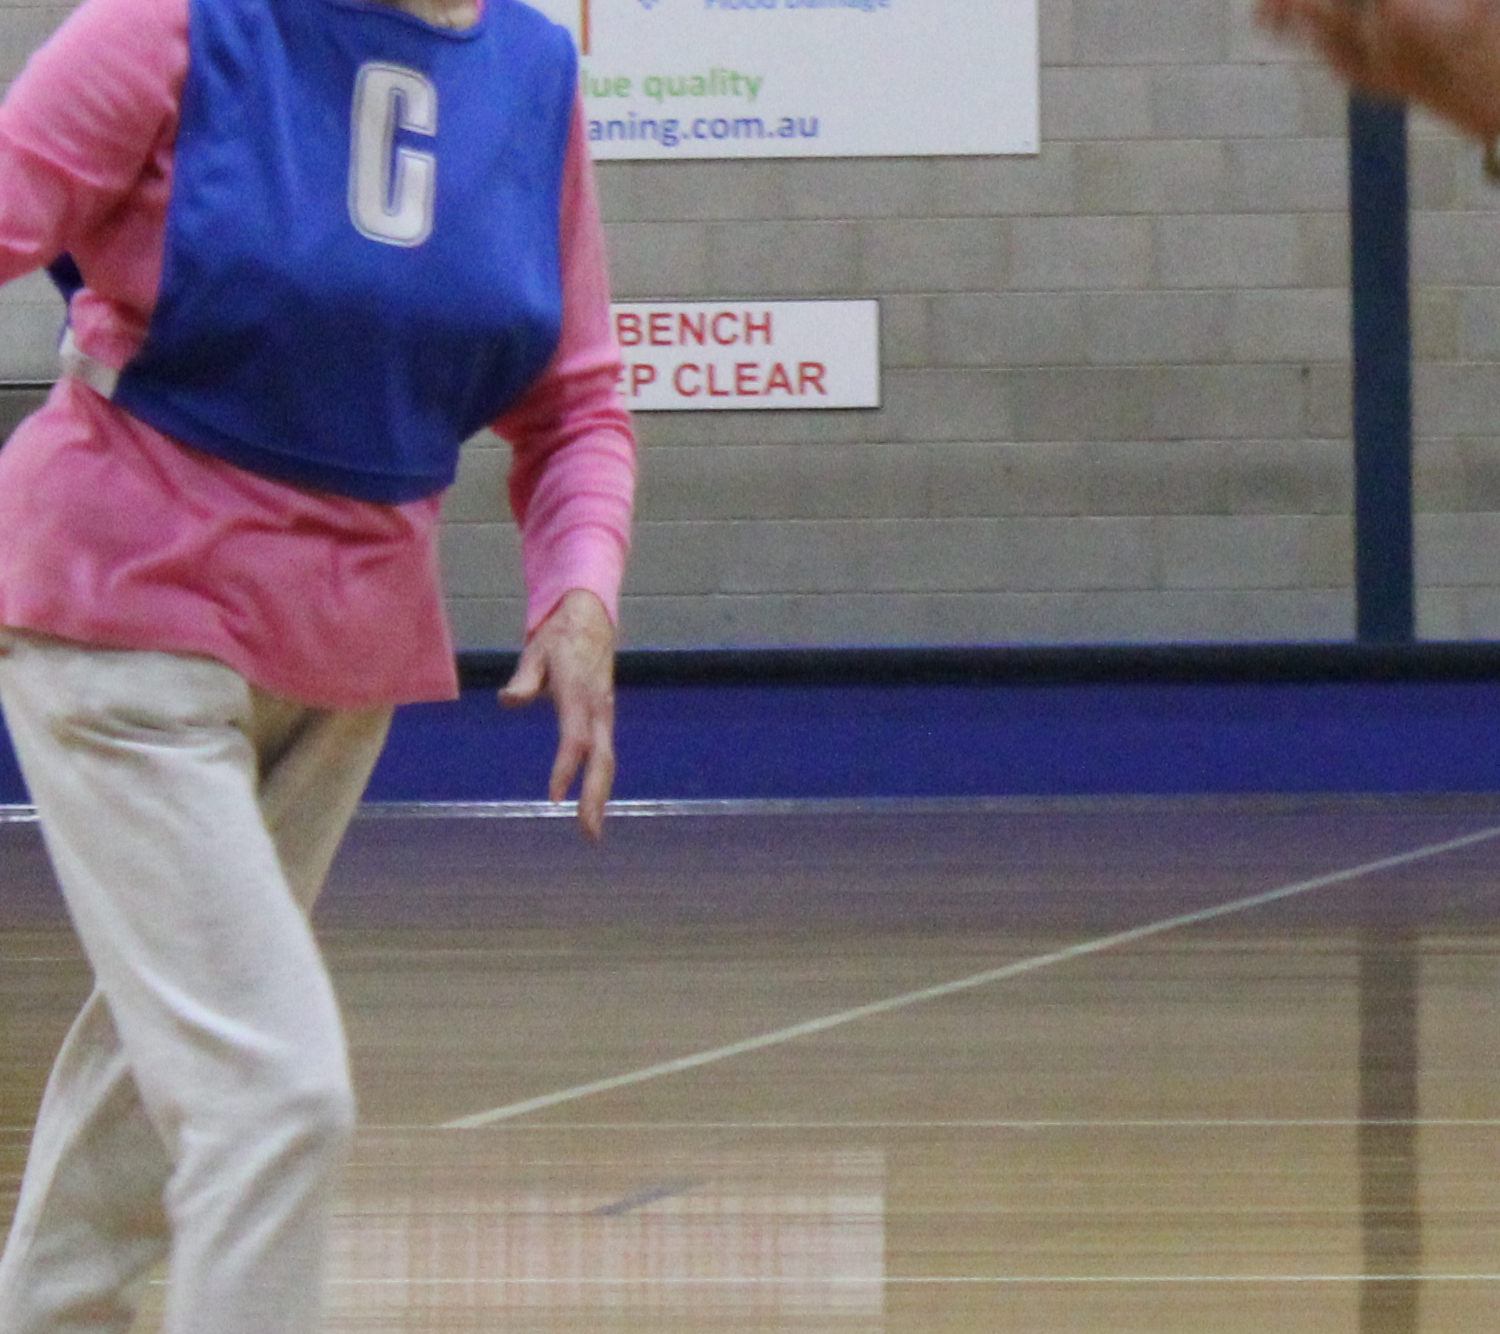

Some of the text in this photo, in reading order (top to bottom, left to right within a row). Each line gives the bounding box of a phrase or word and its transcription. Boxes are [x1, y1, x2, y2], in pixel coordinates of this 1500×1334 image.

[642, 67, 763, 103] quality
[589, 111, 819, 147] aning.com.au
[347, 62, 438, 247] C
[615, 312, 773, 346] BENCH
[673, 361, 828, 397] CLEAR
